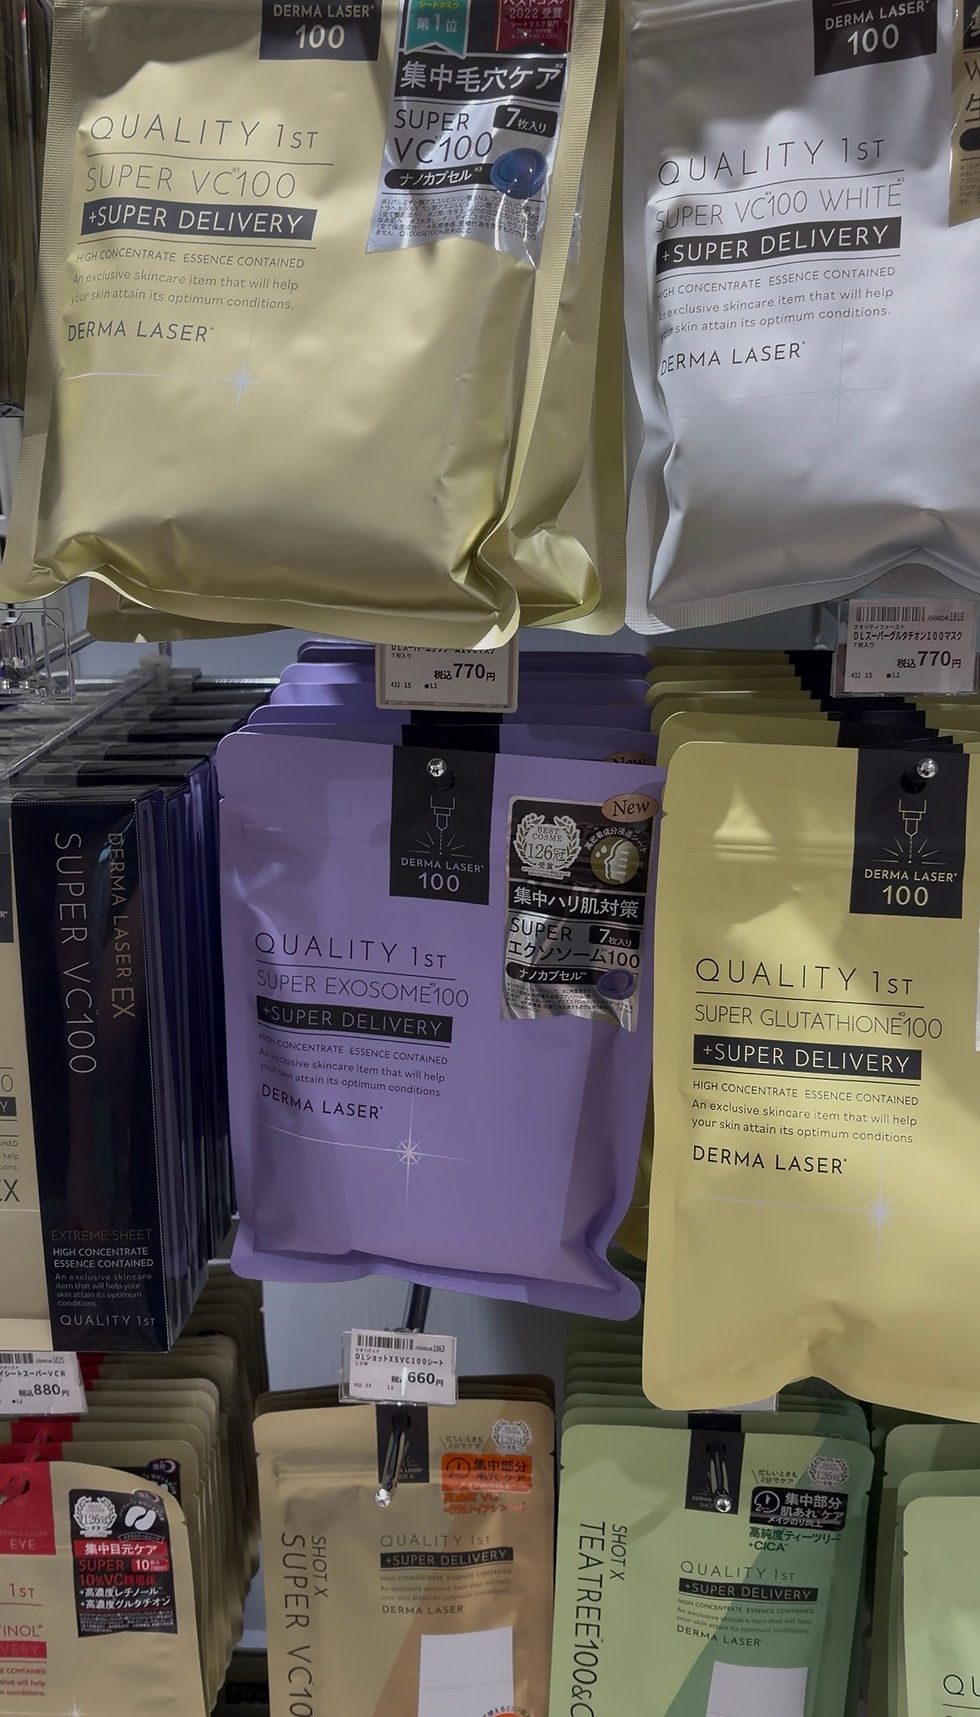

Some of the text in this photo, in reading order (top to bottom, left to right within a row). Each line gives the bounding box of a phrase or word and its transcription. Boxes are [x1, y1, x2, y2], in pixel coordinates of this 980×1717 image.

[273, 5, 322, 18] DERMA
[509, 7, 537, 19] 2022
[825, 12, 874, 32] DERMA
[296, 24, 345, 49] 100
[848, 23, 899, 56] 100
[400, 61, 561, 93] 集中毛穴ケア
[395, 109, 469, 131] SUPER
[506, 107, 546, 133] 7枚入り
[90, 114, 318, 149] QUALITY 1ST
[394, 132, 493, 164] VC100
[658, 137, 884, 186] QUALITY 1ST
[86, 164, 172, 192] SUPER
[400, 167, 472, 186] ナノカプセル
[89, 205, 303, 234] +SUPER DELIVERY
[655, 203, 723, 234] SUPER
[662, 224, 889, 263] +SUPER DELIVERY
[99, 247, 304, 268] CONCENTRATE ESSENCE CONTAINED
[134, 270, 299, 292] skincare that will help
[678, 266, 896, 296] CONCENTRATE ESSENCE CONTAINED
[723, 287, 893, 313] skincare item that help
[759, 311, 815, 327] optimum
[68, 320, 126, 342] DERMA
[660, 349, 721, 377] DERMA
[612, 800, 650, 817] New
[532, 834, 562, 842] COSME
[538, 826, 559, 834] BEST
[107, 832, 128, 906] DERMA
[401, 857, 441, 869] DERMA
[418, 873, 460, 892] 100
[864, 869, 909, 881] DERMA
[54, 832, 88, 944] SUPER
[882, 885, 929, 906] 100
[513, 886, 639, 919] 集中ハリ肌対策
[510, 917, 572, 941] SUPER
[599, 929, 632, 947] 7枚入り
[255, 932, 447, 969] QUALITY 1ST
[256, 969, 316, 993] SUPER
[519, 968, 581, 981] ナノカプセル
[695, 958, 913, 995] QUALITY 1ST
[111, 987, 136, 1019] EX
[262, 1005, 442, 1037] +SUPER DELIVERY
[694, 1004, 753, 1025] SUPER
[276, 1039, 448, 1065] CONCENTRATE ESSENCE CONTAINED
[703, 1042, 910, 1074] +SUPER DELIVERY
[312, 1059, 445, 1083] skincare item that help
[261, 1084, 314, 1113] DERMA
[693, 1081, 919, 1106] HIGH CONCENTRATE ESSENCE CONTAINED
[691, 1099, 917, 1128] An exclusive skincare item that will help
[691, 1117, 849, 1140] your skin attain its optimum
[693, 1145, 765, 1169] DERMA
[51, 1229, 152, 1240] EXTREME SHEET
[53, 1247, 148, 1256] HIGH CONCENTRATE
[54, 1259, 153, 1268] ESSENCE CONTAINED
[60, 1315, 155, 1326] QUALITY 1ST
[785, 1492, 842, 1509] 集中部分
[768, 1517, 823, 1528] メイクのり向上
[10, 1539, 36, 1550] EYE
[380, 1535, 490, 1547] QUALITY 1ST
[749, 1527, 841, 1544] 高純度ティーツリー
[85, 1543, 157, 1555] 集中目元ケア
[387, 1550, 507, 1566] +SUPER DELIVERY
[609, 1523, 627, 1580] SHOT X
[79, 1560, 124, 1571] SUPER
[311, 1536, 328, 1597] SHOT X
[680, 1560, 795, 1581] QUALITY 1ST
[9, 1583, 34, 1598] 1ST
[281, 1532, 310, 1629] SUPER
[685, 1582, 812, 1600] +SUPER DELIVERY
[382, 1605, 422, 1614] DERMA
[676, 1624, 718, 1641] DERMA
